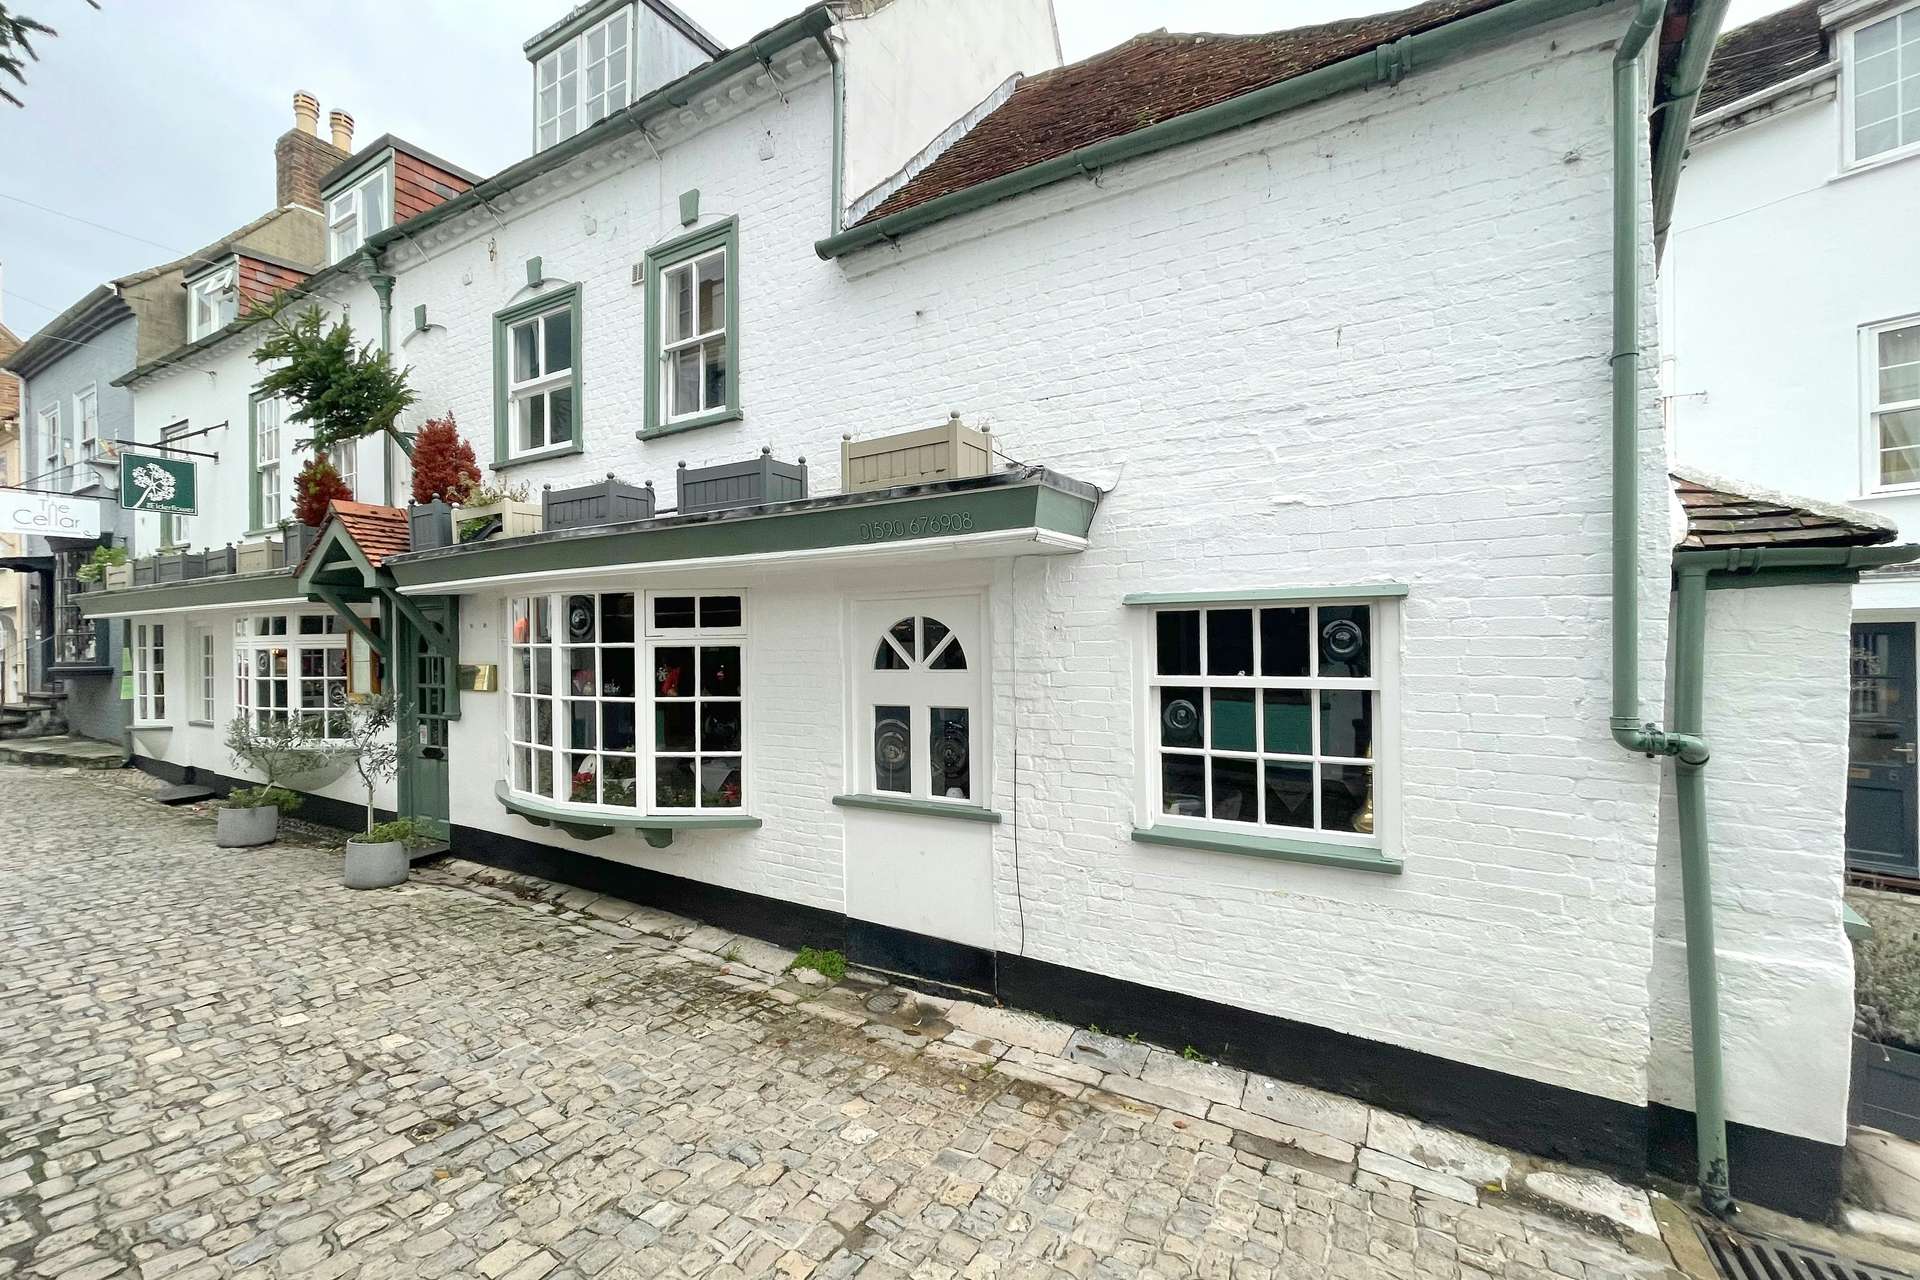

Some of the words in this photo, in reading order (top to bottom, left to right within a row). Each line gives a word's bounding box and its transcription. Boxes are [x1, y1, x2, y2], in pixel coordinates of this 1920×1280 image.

[13, 506, 81, 529] Cellar
[39, 499, 70, 513] The
[859, 519, 904, 540] 01590
[909, 511, 973, 535] 676908
